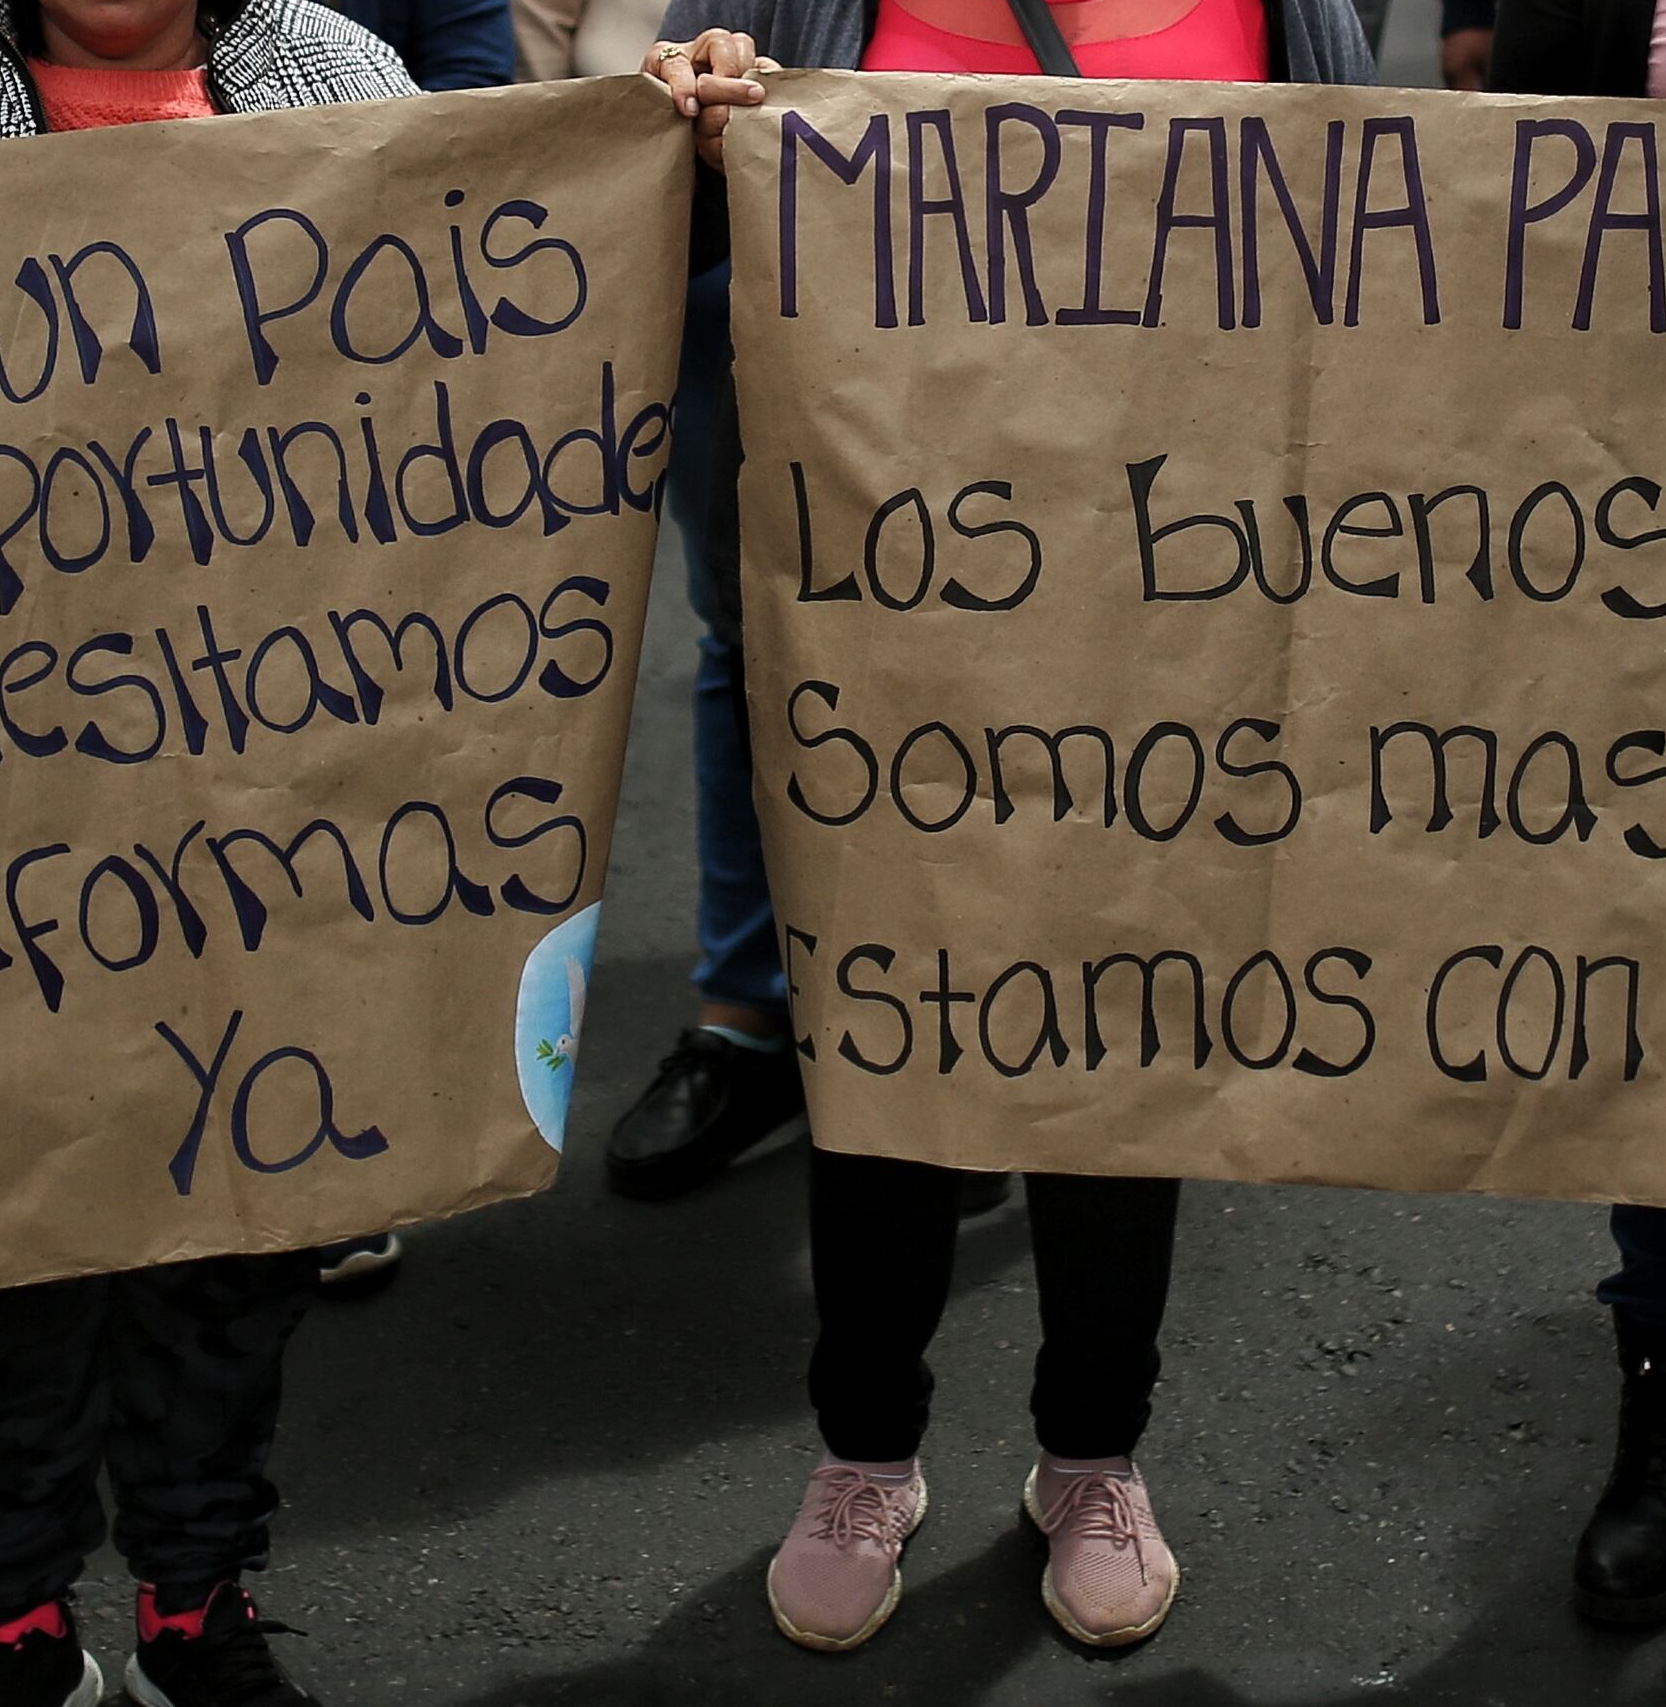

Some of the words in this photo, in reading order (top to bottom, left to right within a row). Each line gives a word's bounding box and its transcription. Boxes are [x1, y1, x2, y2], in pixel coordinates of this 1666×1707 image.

[779, 102, 1440, 331] MARIANA
[790, 460, 1042, 611] Los
[787, 681, 1302, 846] Somos
[785, 924, 1376, 1078] Estamos
[154, 1010, 390, 1196] Ya
